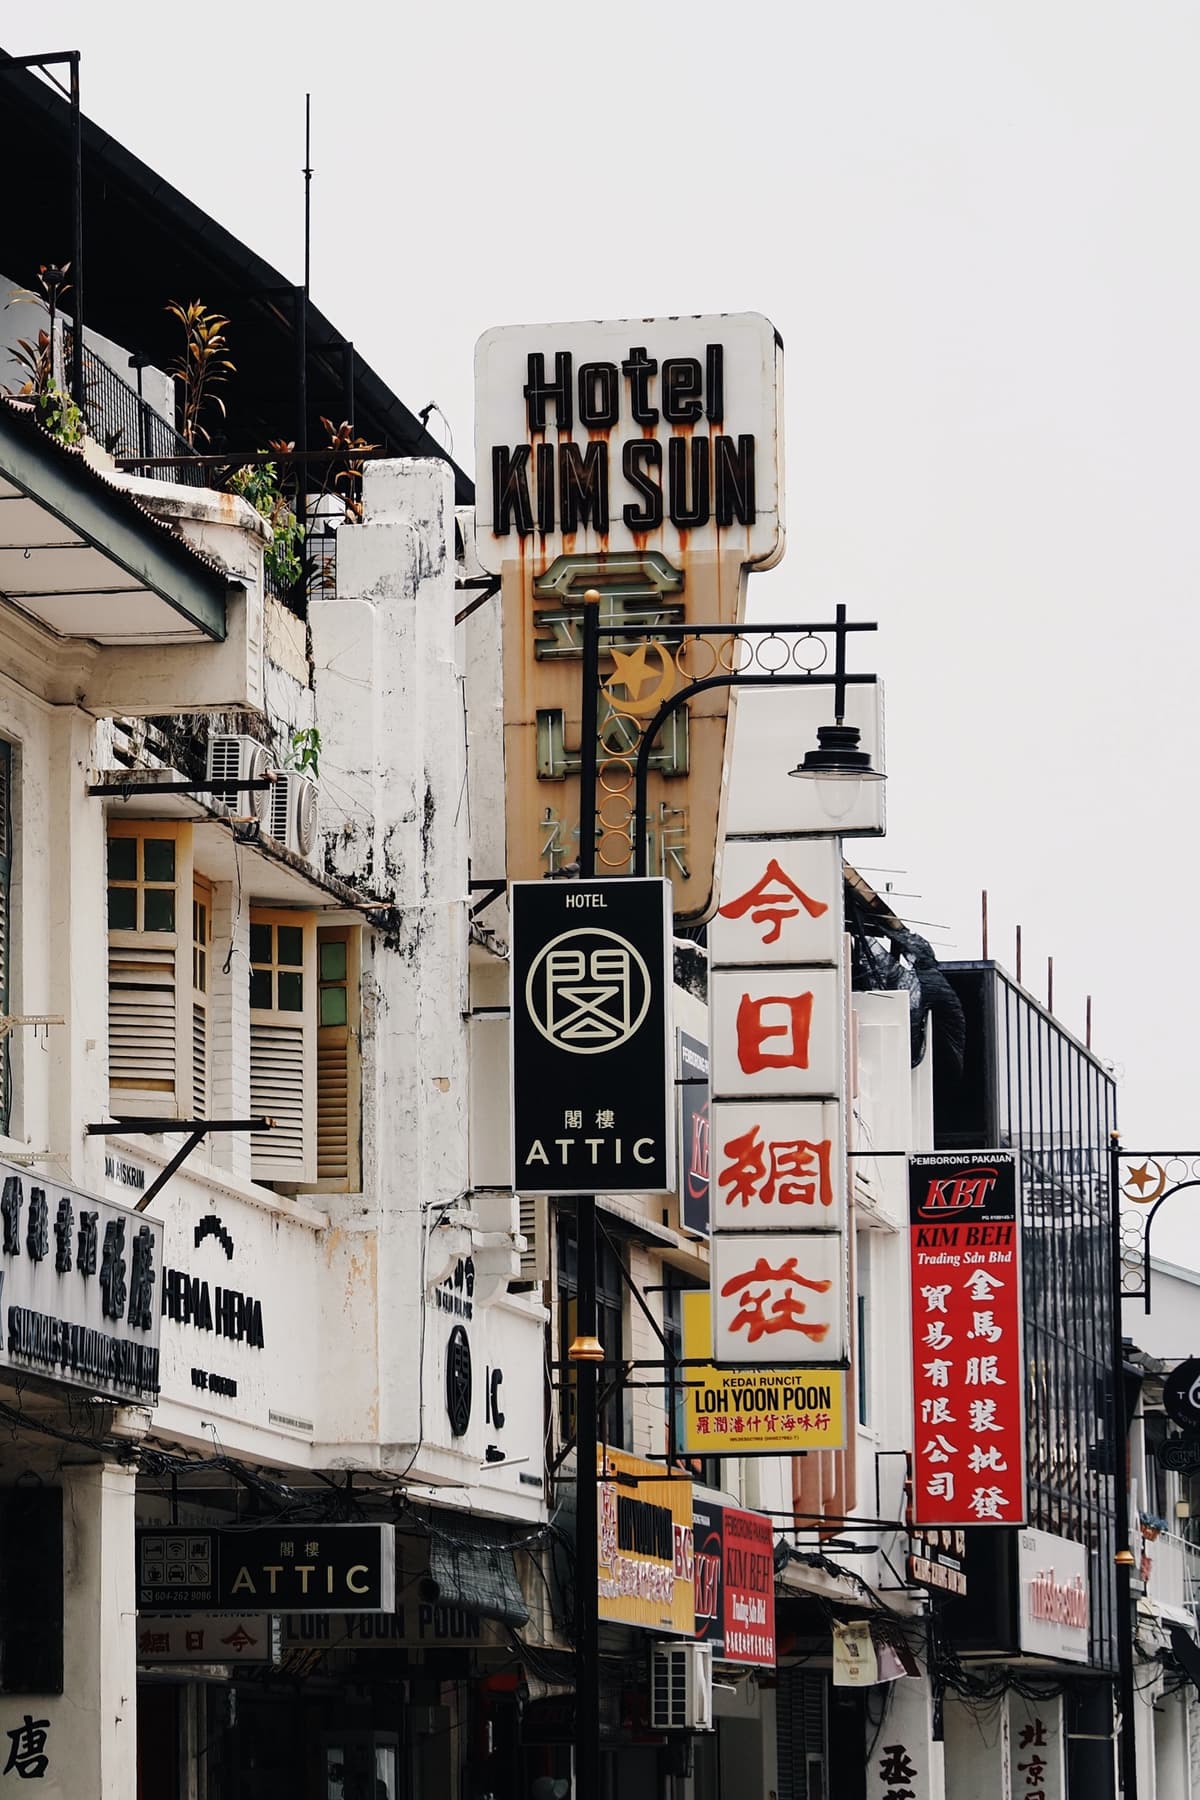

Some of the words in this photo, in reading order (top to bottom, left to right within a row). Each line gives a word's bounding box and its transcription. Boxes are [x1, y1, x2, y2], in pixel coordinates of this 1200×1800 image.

[523, 344, 724, 432] Hotel
[492, 440, 609, 536] KIM
[622, 434, 756, 534] SUN
[566, 894, 608, 908] HOTEL
[564, 1109, 616, 1130] 閣樓
[525, 1138, 656, 1165] ATTIC
[910, 1156, 970, 1165] PEMBORONG
[971, 1154, 1012, 1163] PAKAIAN
[116, 1160, 145, 1190] AISKRIM
[922, 1179, 997, 1209] KBT
[916, 1227, 960, 1248] KIM
[966, 1225, 1013, 1246] BEH
[918, 1252, 960, 1267] Trading
[963, 1251, 986, 1264] Sdn
[989, 1250, 1013, 1263] Bhd
[162, 1266, 213, 1332] HEMA
[215, 1287, 265, 1349] HEMA
[723, 1377, 756, 1387] KEDAI
[760, 1376, 802, 1386] RUNCIT
[920, 1284, 959, 1502] 貿易有限公司
[963, 1268, 1009, 1520] 金馬服裝批發
[695, 1388, 728, 1413] LOH
[731, 1387, 779, 1412] YOON
[783, 1386, 831, 1410] POON
[231, 1565, 370, 1594] ATTIC
[2, 1715, 51, 1778] 唐
